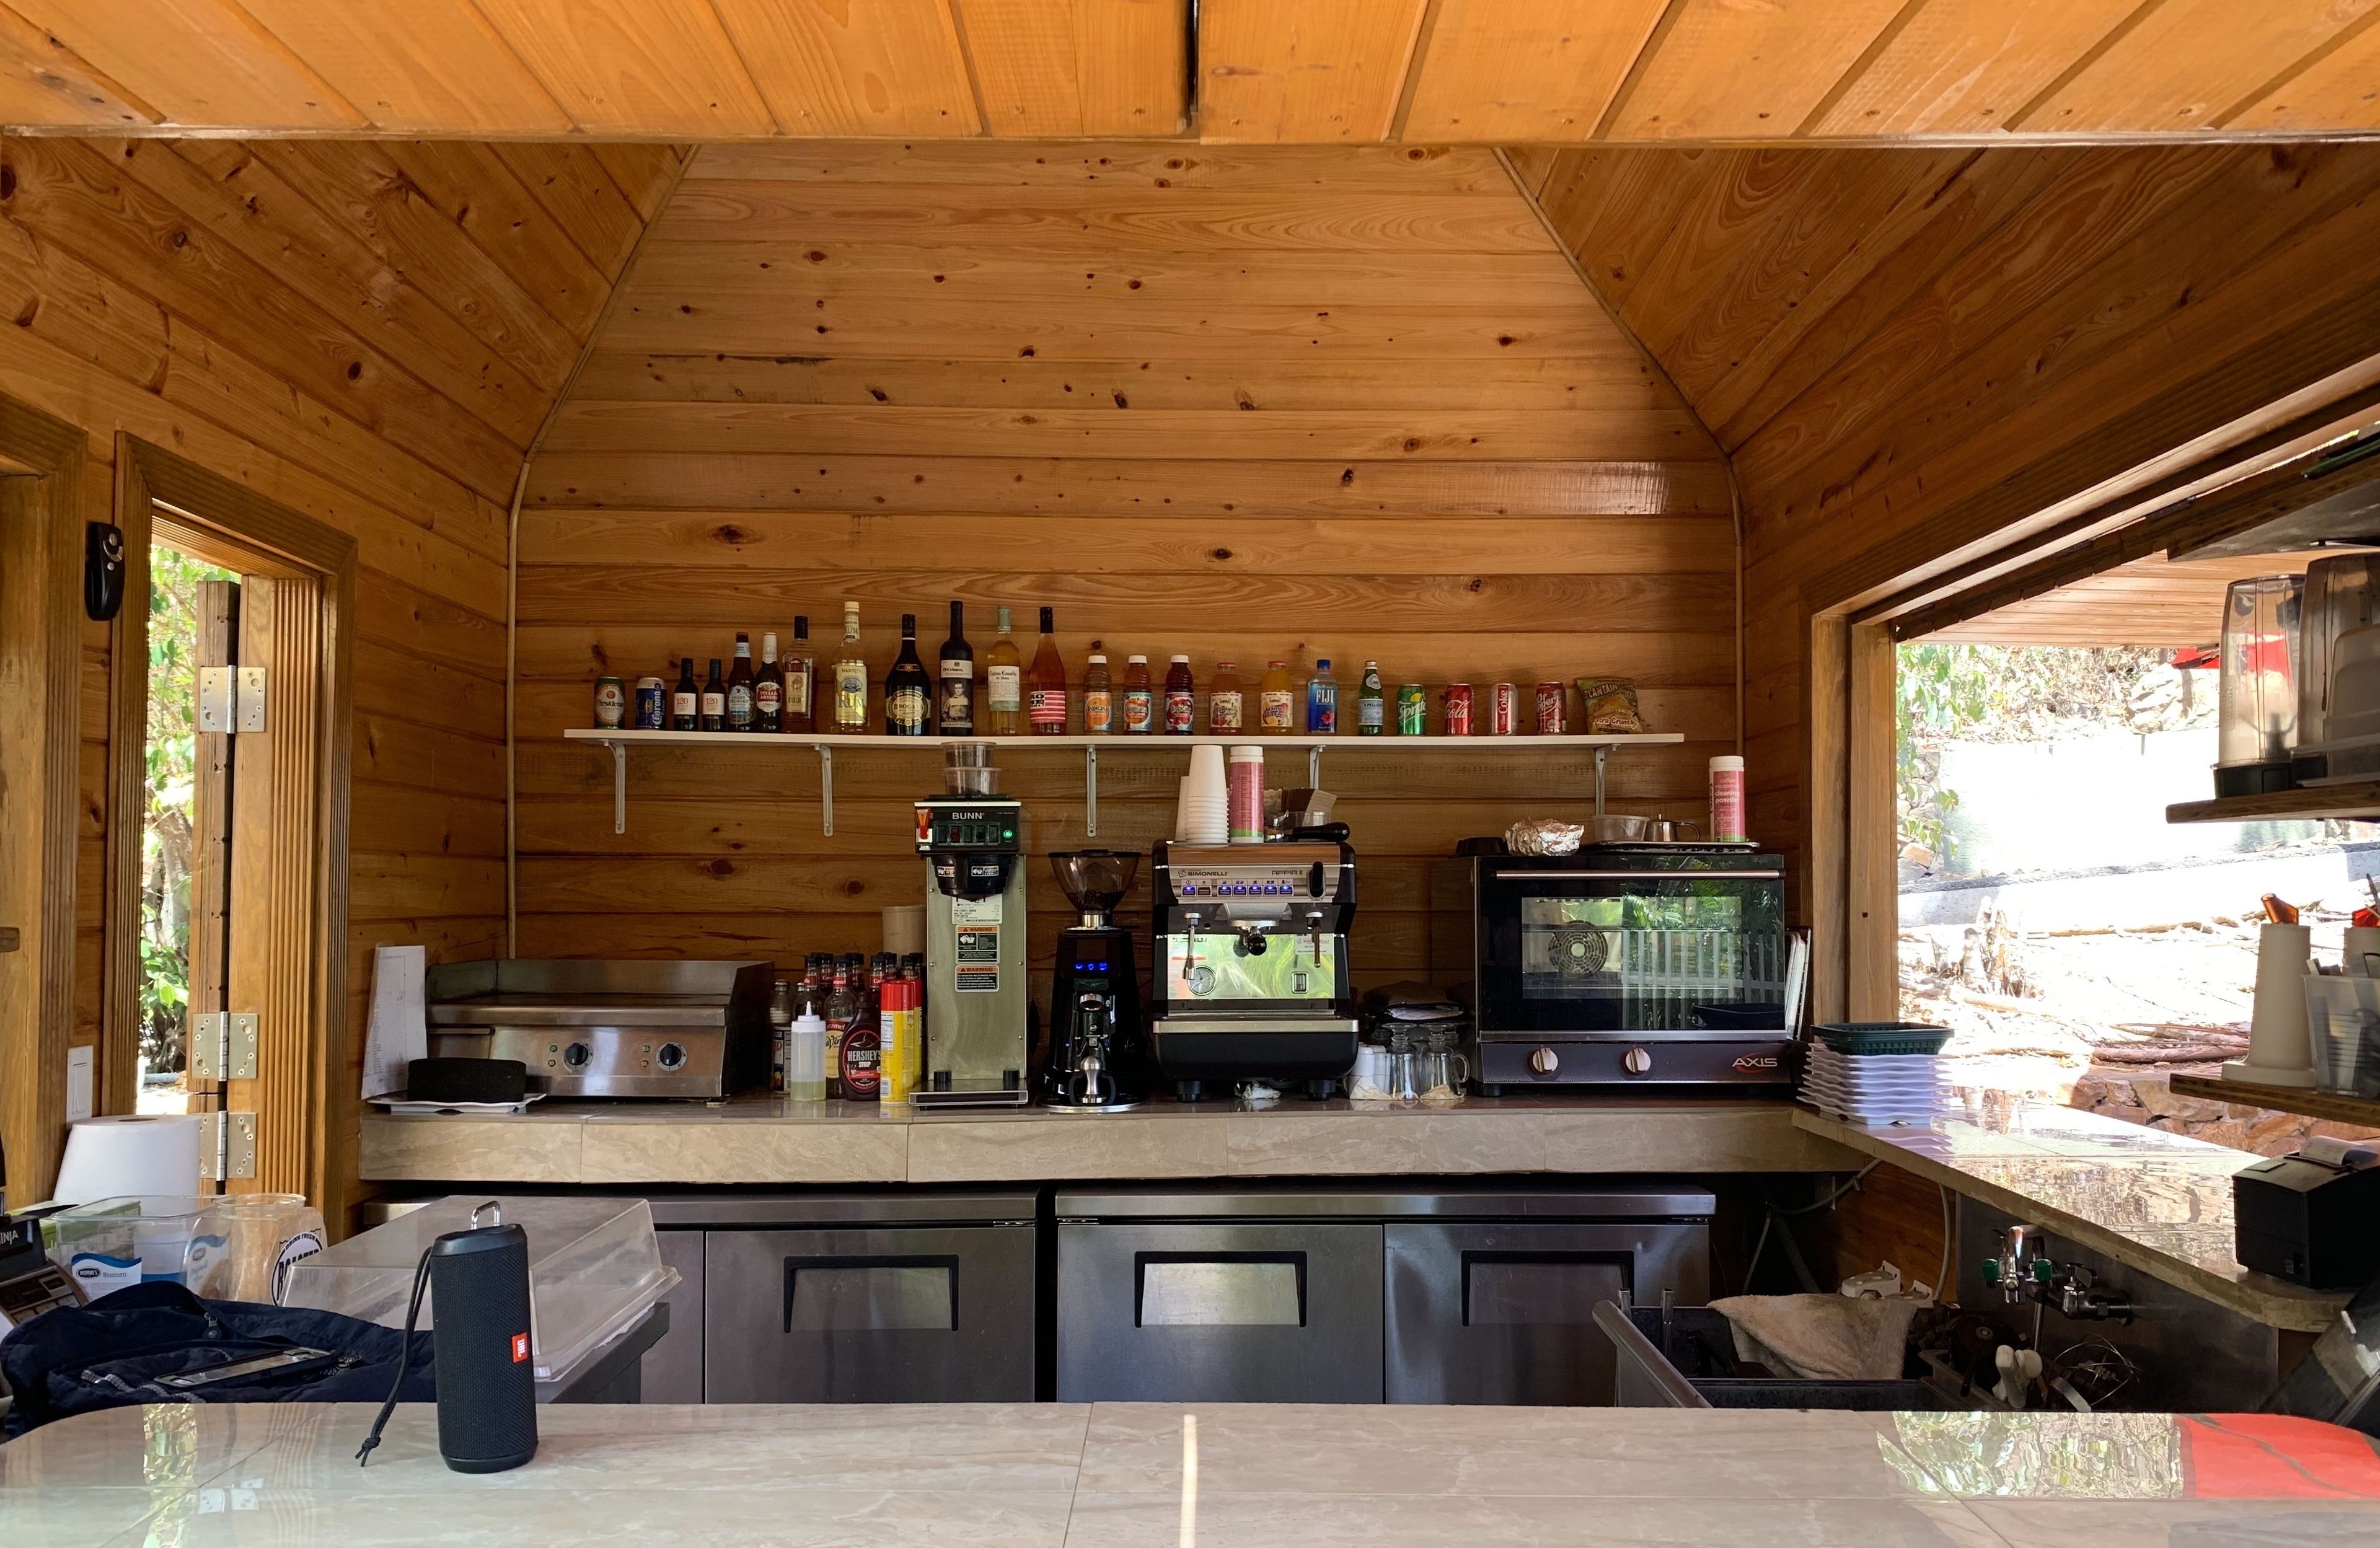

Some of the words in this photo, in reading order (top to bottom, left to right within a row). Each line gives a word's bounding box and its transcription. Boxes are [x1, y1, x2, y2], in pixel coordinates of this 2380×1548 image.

[838, 695, 865, 708] RUM
[1315, 689, 1334, 703] FIJI
[1498, 690, 1508, 715] Coke
[651, 690, 663, 725] Corona
[1444, 699, 1471, 719] Cola
[1611, 716, 1639, 729] Crunchy
[1715, 796, 1740, 804] powder
[847, 1050, 881, 1062] HERSHEY'S
[1732, 1057, 1778, 1067] AXIS
[301, 1233, 315, 1241] FRESH
[517, 1338, 526, 1358] JBL
